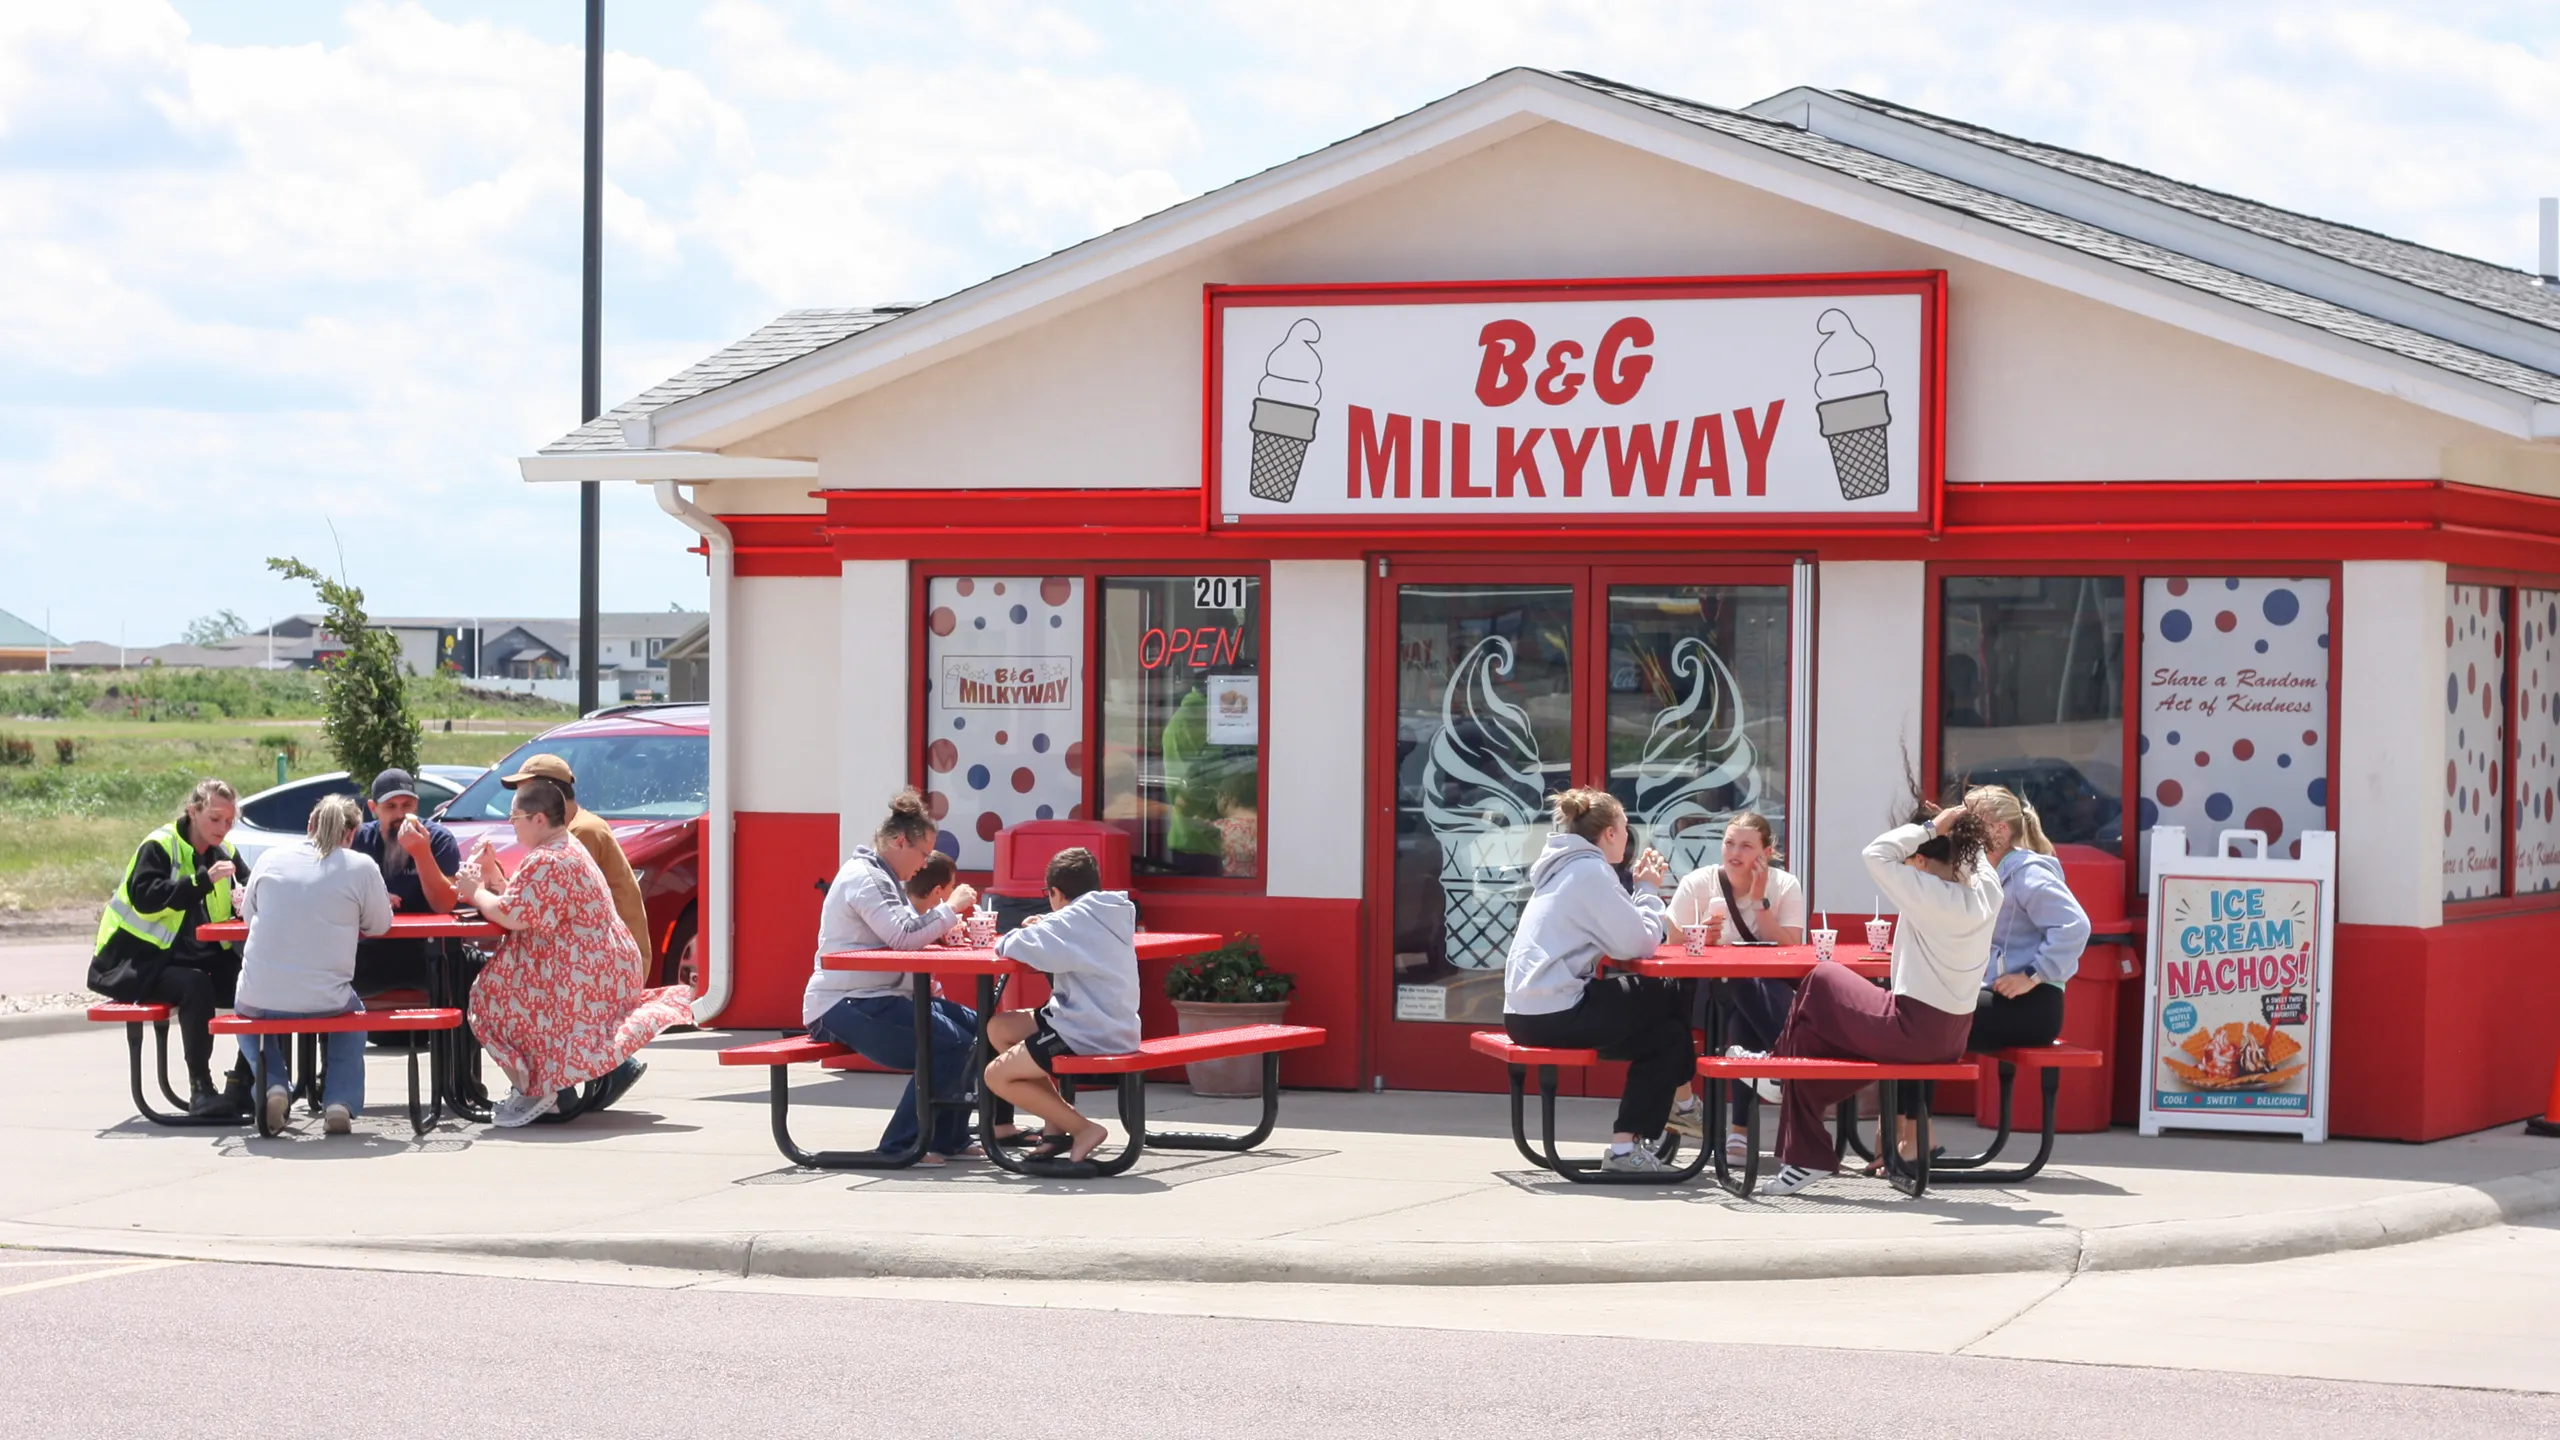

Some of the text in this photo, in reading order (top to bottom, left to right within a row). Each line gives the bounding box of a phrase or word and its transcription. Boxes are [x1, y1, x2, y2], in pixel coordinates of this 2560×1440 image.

[1475, 316, 1654, 407] B&G
[1346, 399, 1786, 499] MILKYWAY
[1197, 578, 1242, 607] 201
[1139, 627, 1244, 669] OPEN
[960, 677, 1068, 704] MILKYWAY
[995, 667, 1034, 684] B&G
[2151, 668, 2317, 688] Share a Random
[2155, 693, 2313, 717] Act of Kindness
[2210, 888, 2264, 921] ICE
[2180, 919, 2293, 956] CREAM
[2167, 951, 2310, 997] NACHOS!
[2162, 1095, 2301, 1106] COOL! SWEET! DELICIOUS!
